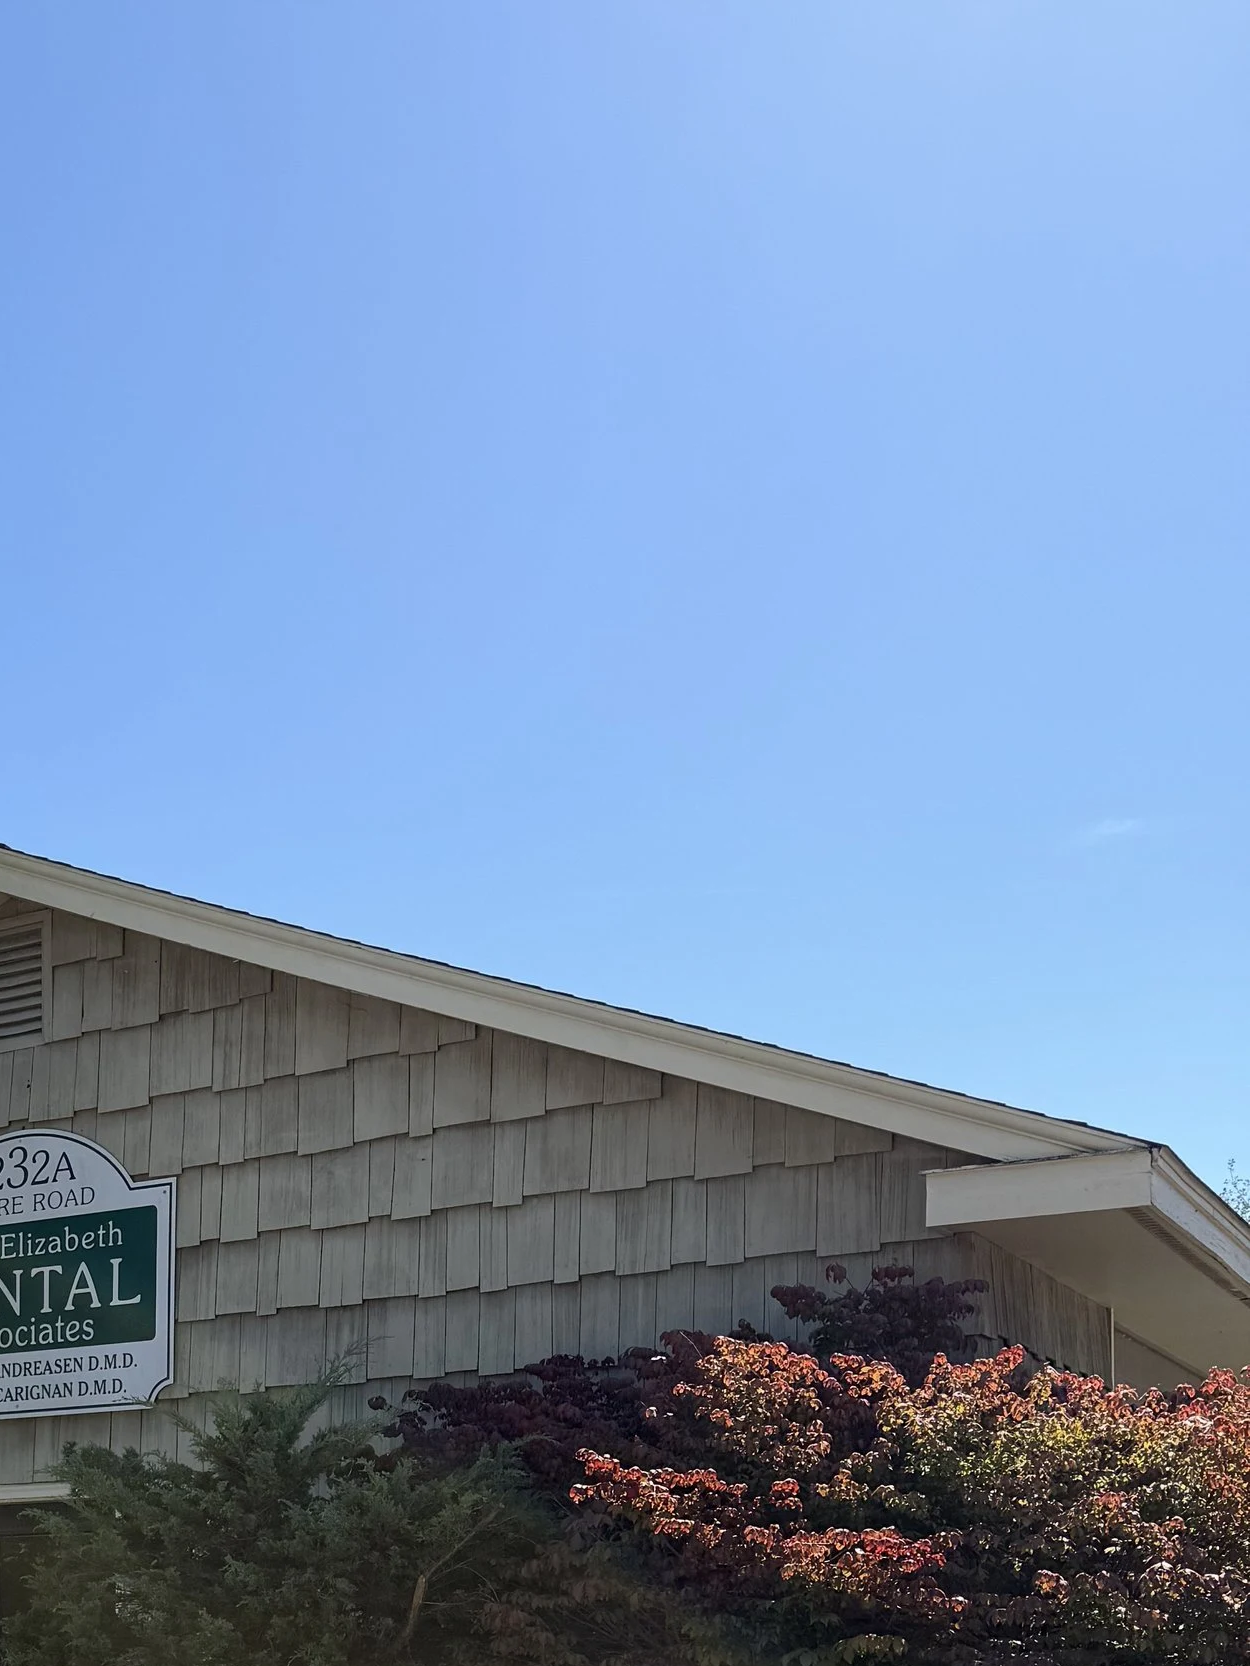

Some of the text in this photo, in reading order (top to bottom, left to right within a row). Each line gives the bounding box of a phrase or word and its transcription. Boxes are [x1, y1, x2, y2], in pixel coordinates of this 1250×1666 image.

[32, 1187, 95, 1211] ROAD
[0, 1221, 123, 1260] Elizabeth
[88, 1353, 137, 1371] D.M.D.
[78, 1379, 127, 1397] D.M.D.
